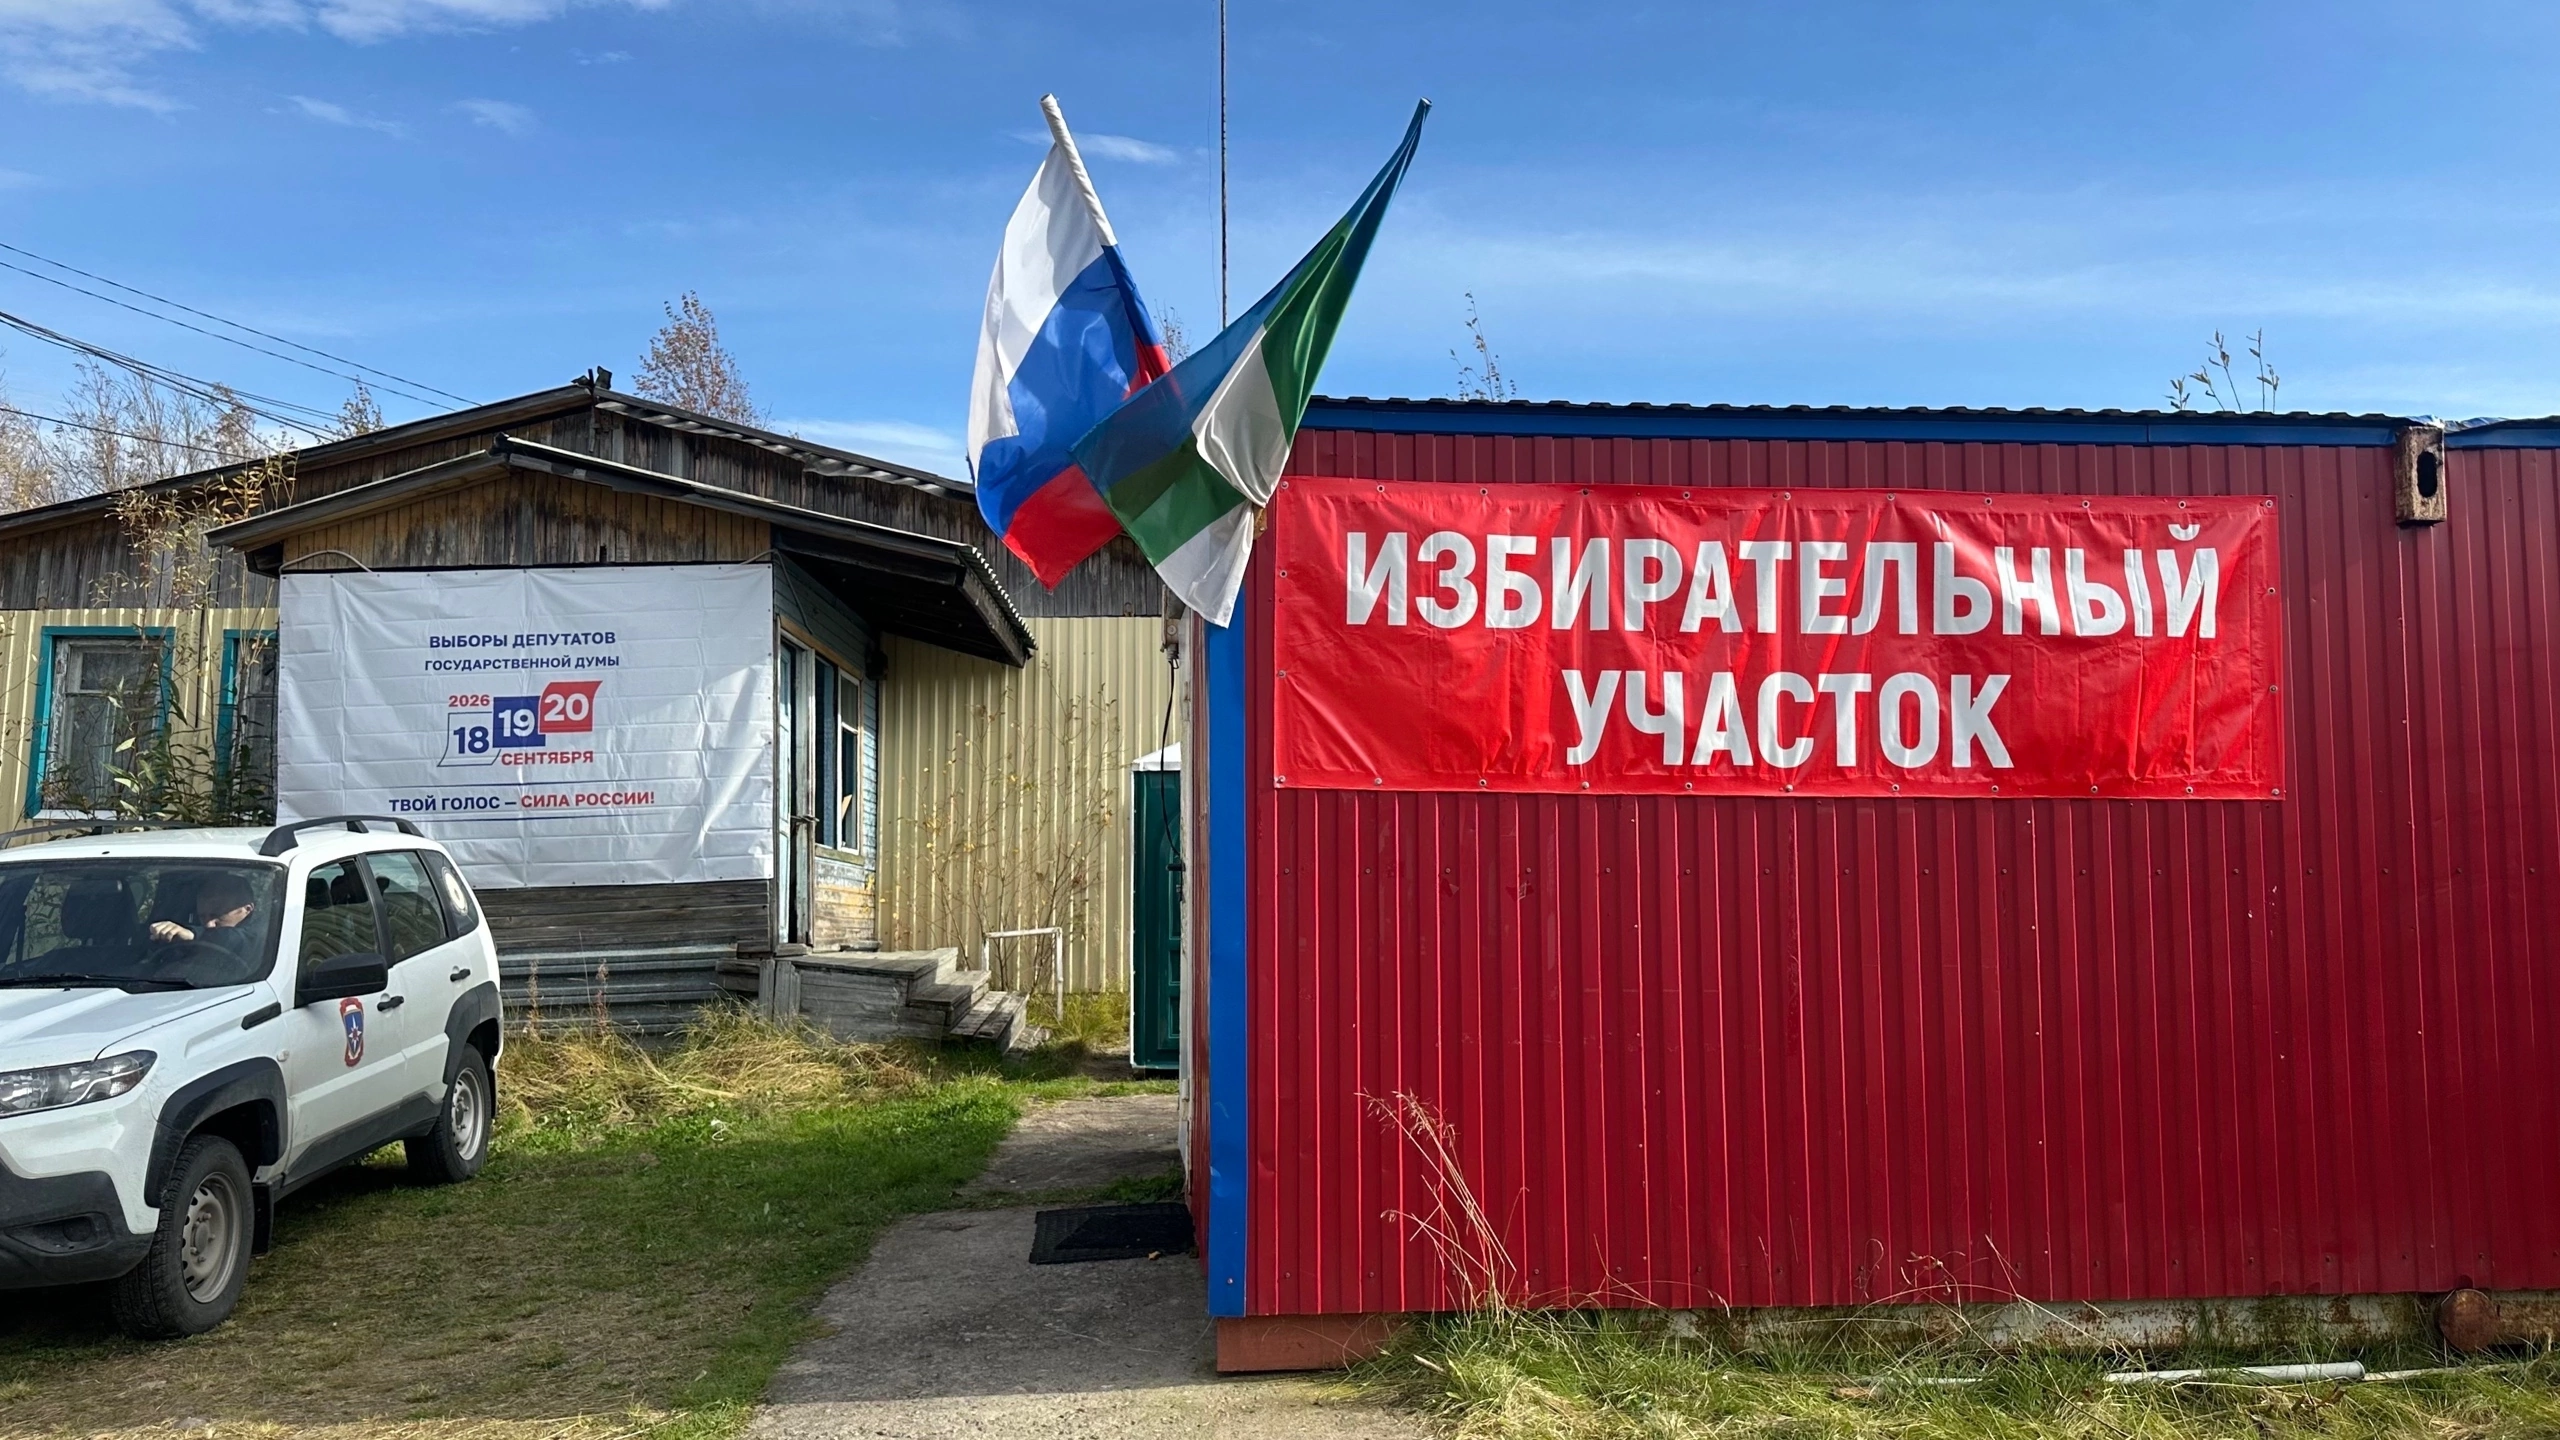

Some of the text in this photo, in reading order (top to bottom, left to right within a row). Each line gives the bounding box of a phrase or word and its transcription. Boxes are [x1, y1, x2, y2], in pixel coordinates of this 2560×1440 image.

[1345, 523, 2221, 640] ИЗБИРАТЕЛЬНЫЙ
[429, 632, 616, 649] ВЫБОРЫ ДЕПУТАТОВ
[425, 656, 620, 672] ГОСУДАРСТВЕННОЙ ДУМЫ
[448, 694, 490, 708] 2026
[453, 693, 590, 755] 18 19 20
[1564, 669, 2014, 770] УЧАСТОК
[501, 751, 594, 766] СЕНТЯБРЯ
[389, 796, 437, 813] ТВОЙ
[441, 796, 500, 811] ГОЛОС
[521, 794, 570, 808] СИЛА
[575, 791, 655, 807] РОССИИ!
